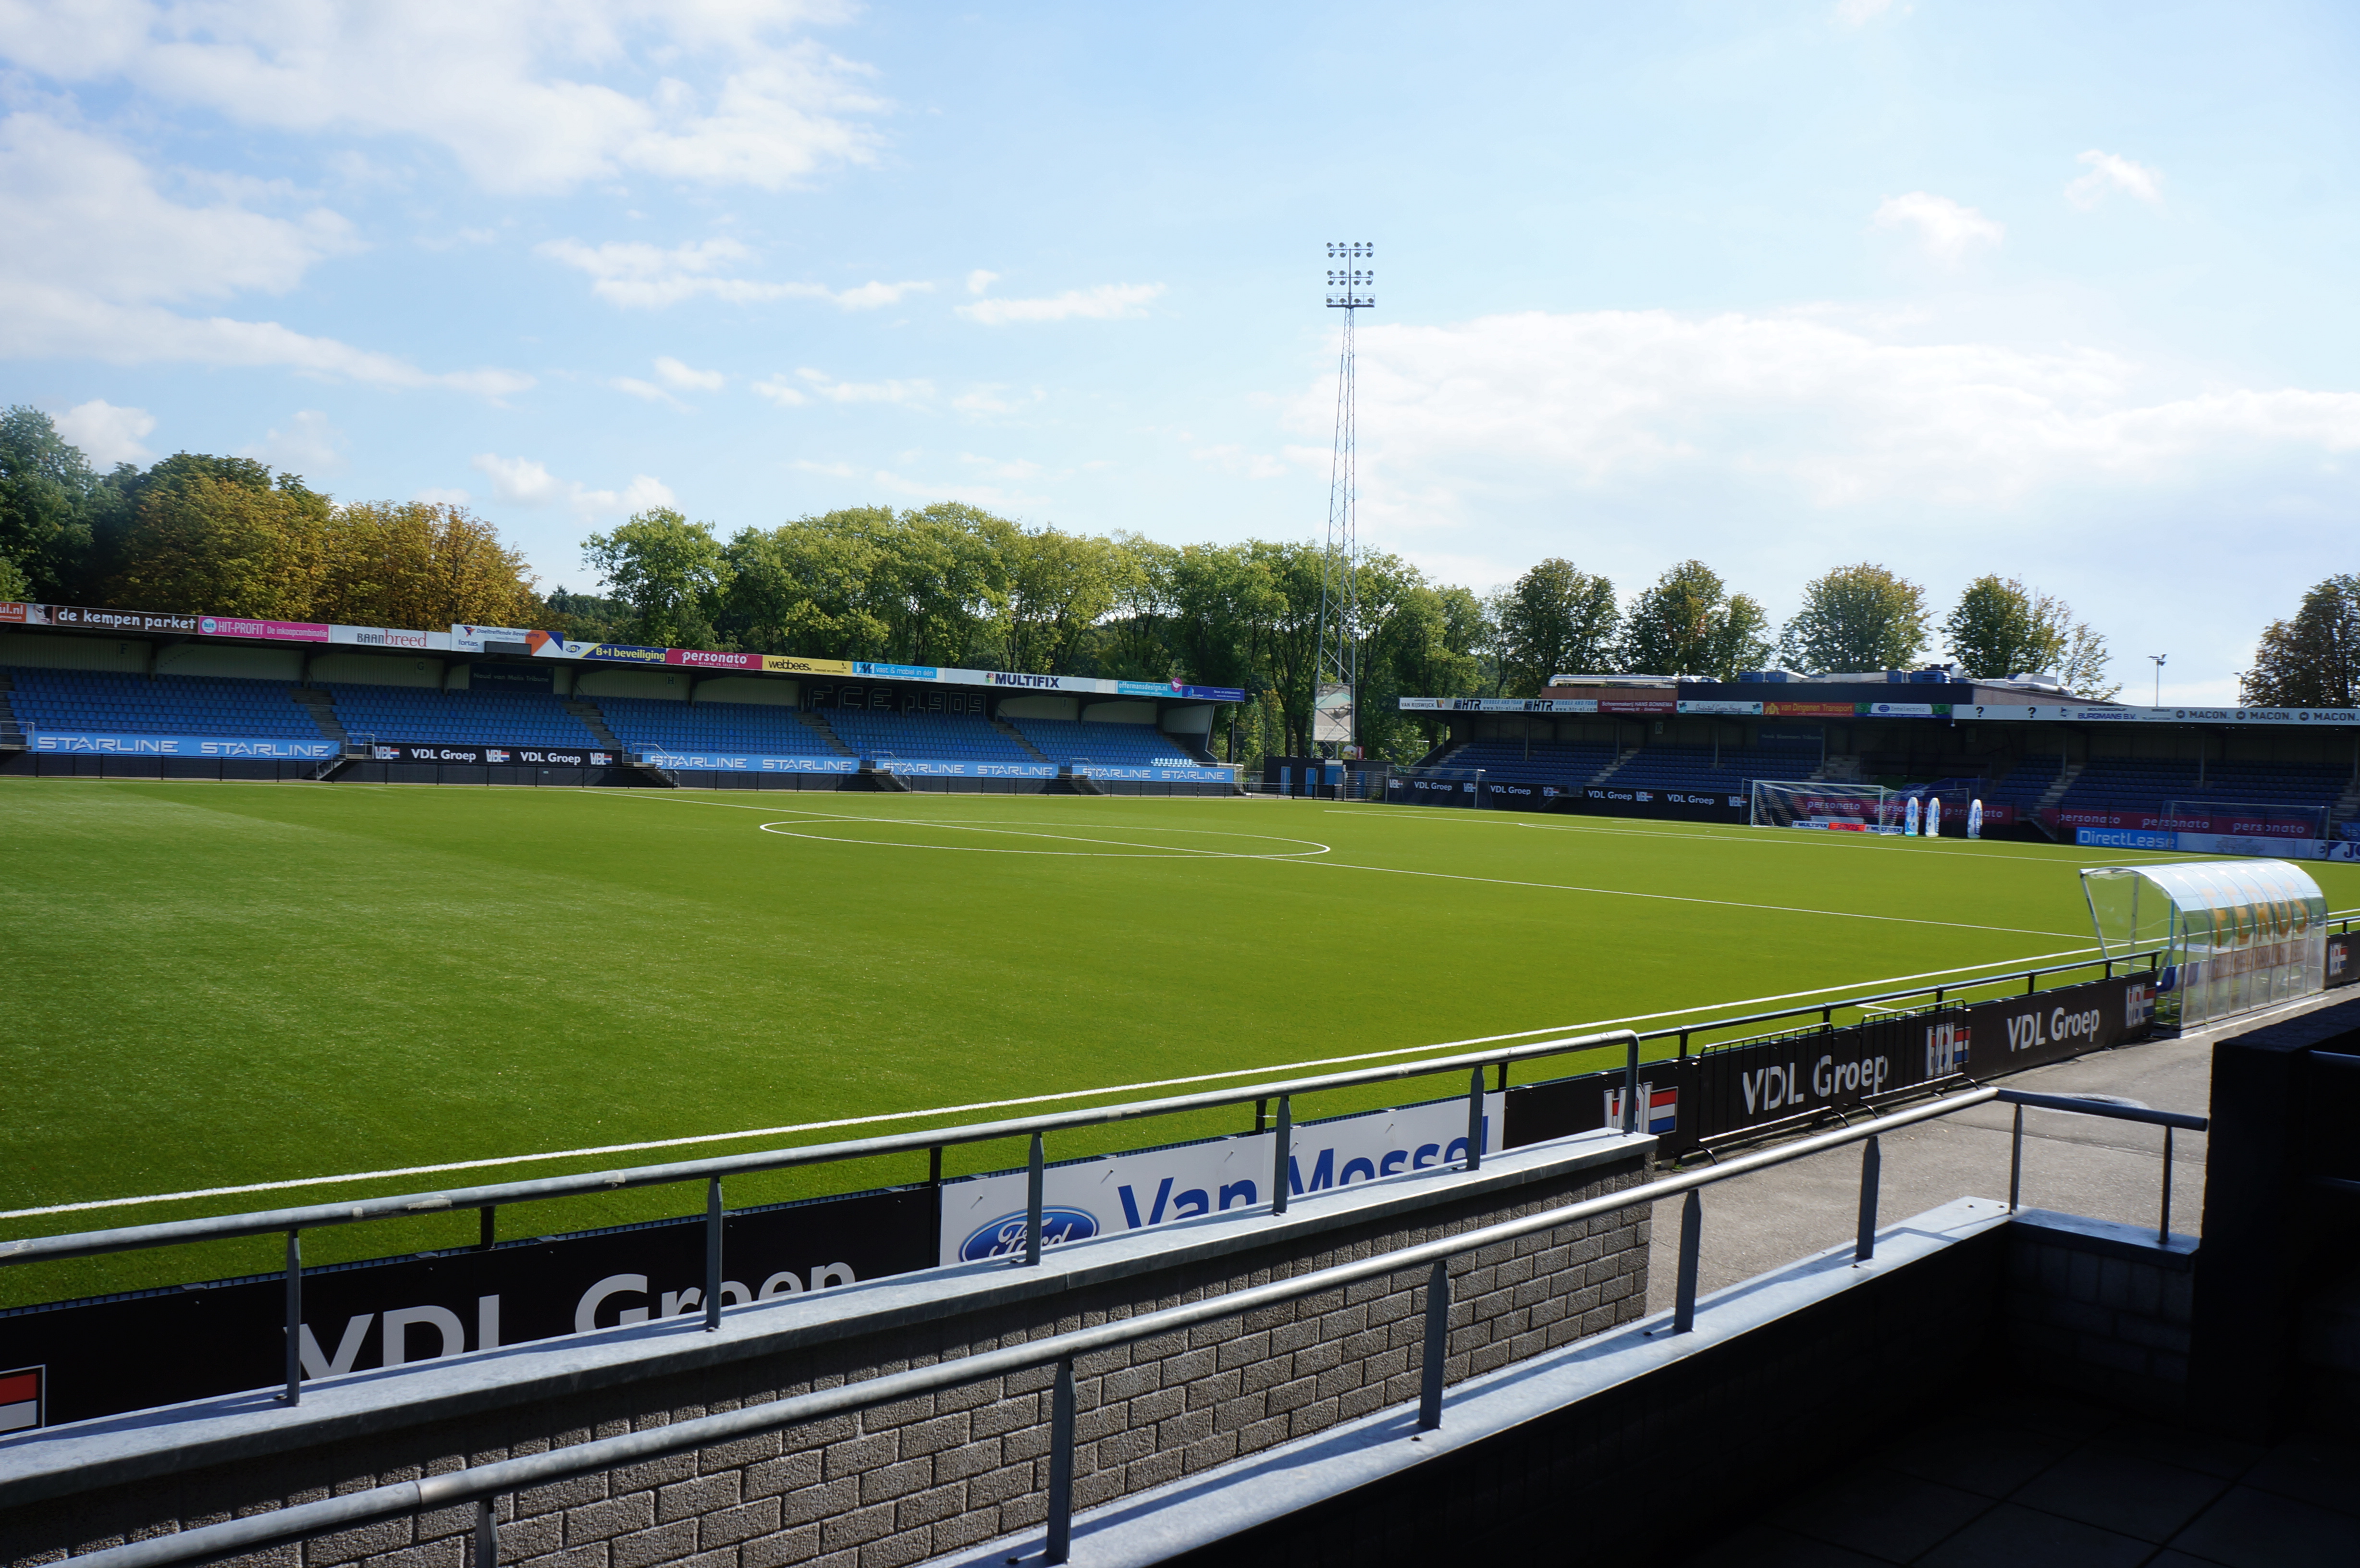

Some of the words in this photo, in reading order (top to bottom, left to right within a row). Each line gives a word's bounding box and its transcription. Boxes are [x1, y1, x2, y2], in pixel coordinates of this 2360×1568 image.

[58, 608, 77, 621] de
[83, 610, 140, 628] kempen
[145, 615, 196, 630] parket
[218, 621, 264, 635] HIT-PROFIT
[267, 626, 275, 635] De
[596, 647, 612, 657] B+I
[614, 647, 665, 662] beveiliging
[681, 651, 748, 664] personato
[995, 673, 1060, 688] MULTIFIX
[1119, 681, 1168, 692] offermansdesign.nl
[1462, 699, 1481, 710] HTR
[1533, 700, 1554, 711] HTR
[1822, 704, 1853, 712] Transport
[37, 736, 179, 753] STARLINE
[200, 741, 329, 757] STARLINE
[411, 748, 438, 759] VDL
[440, 749, 477, 763] Groep
[520, 751, 545, 762] VDL
[547, 752, 581, 765] Groep
[650, 755, 747, 769] STARLINE
[762, 759, 852, 771] STARLINE
[883, 762, 965, 774] STARLINE
[977, 764, 1053, 776] STARLINE
[1082, 767, 1151, 778] STARLINE
[1161, 769, 1225, 780] STARLINE
[1414, 781, 1429, 789] VDL
[1430, 782, 1452, 791] Groep
[1490, 785, 1507, 793] VDL
[1508, 786, 1531, 796] Groep
[1587, 790, 1606, 799] VDL
[1607, 791, 1633, 801] Groep
[1667, 794, 1686, 803] VDL
[1688, 795, 1715, 805] Groep
[2078, 830, 2176, 849] DirectLease
[2006, 1014, 2046, 1053] VDL
[2050, 1006, 2101, 1042] Groep
[1742, 1062, 1805, 1115] VDL
[1813, 1054, 1889, 1097] Groep
[1118, 1177, 1257, 1229] Van
